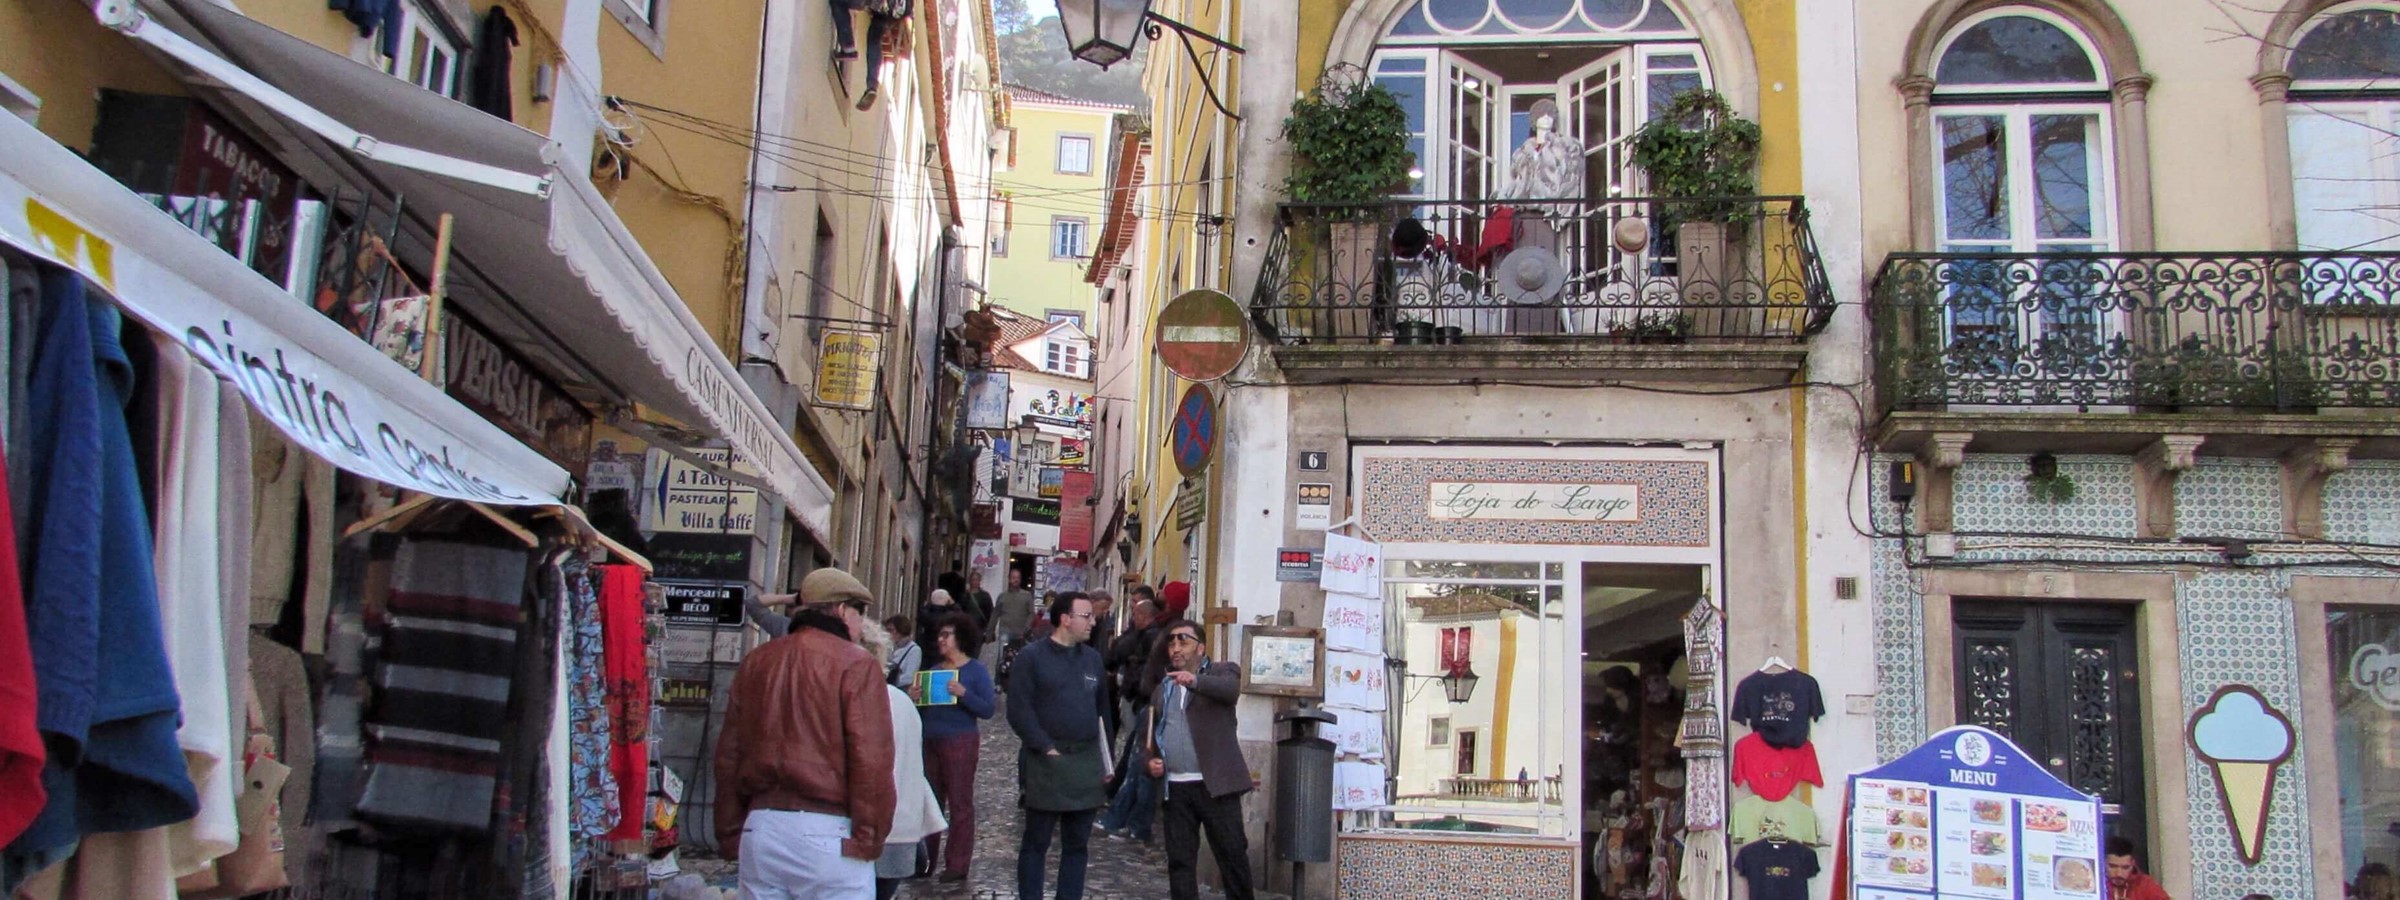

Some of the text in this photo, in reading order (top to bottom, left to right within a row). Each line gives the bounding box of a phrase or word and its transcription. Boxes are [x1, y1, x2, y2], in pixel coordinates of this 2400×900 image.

[1308, 453, 1319, 468] 6
[690, 470, 746, 486] Tave
[669, 495, 739, 505] PASTELARA
[1435, 484, 1632, 520] Loja do Largo
[681, 511, 714, 528] Villa
[665, 586, 730, 599] Mercearia
[683, 603, 710, 612] BECO
[1950, 769, 1997, 786] MENU
